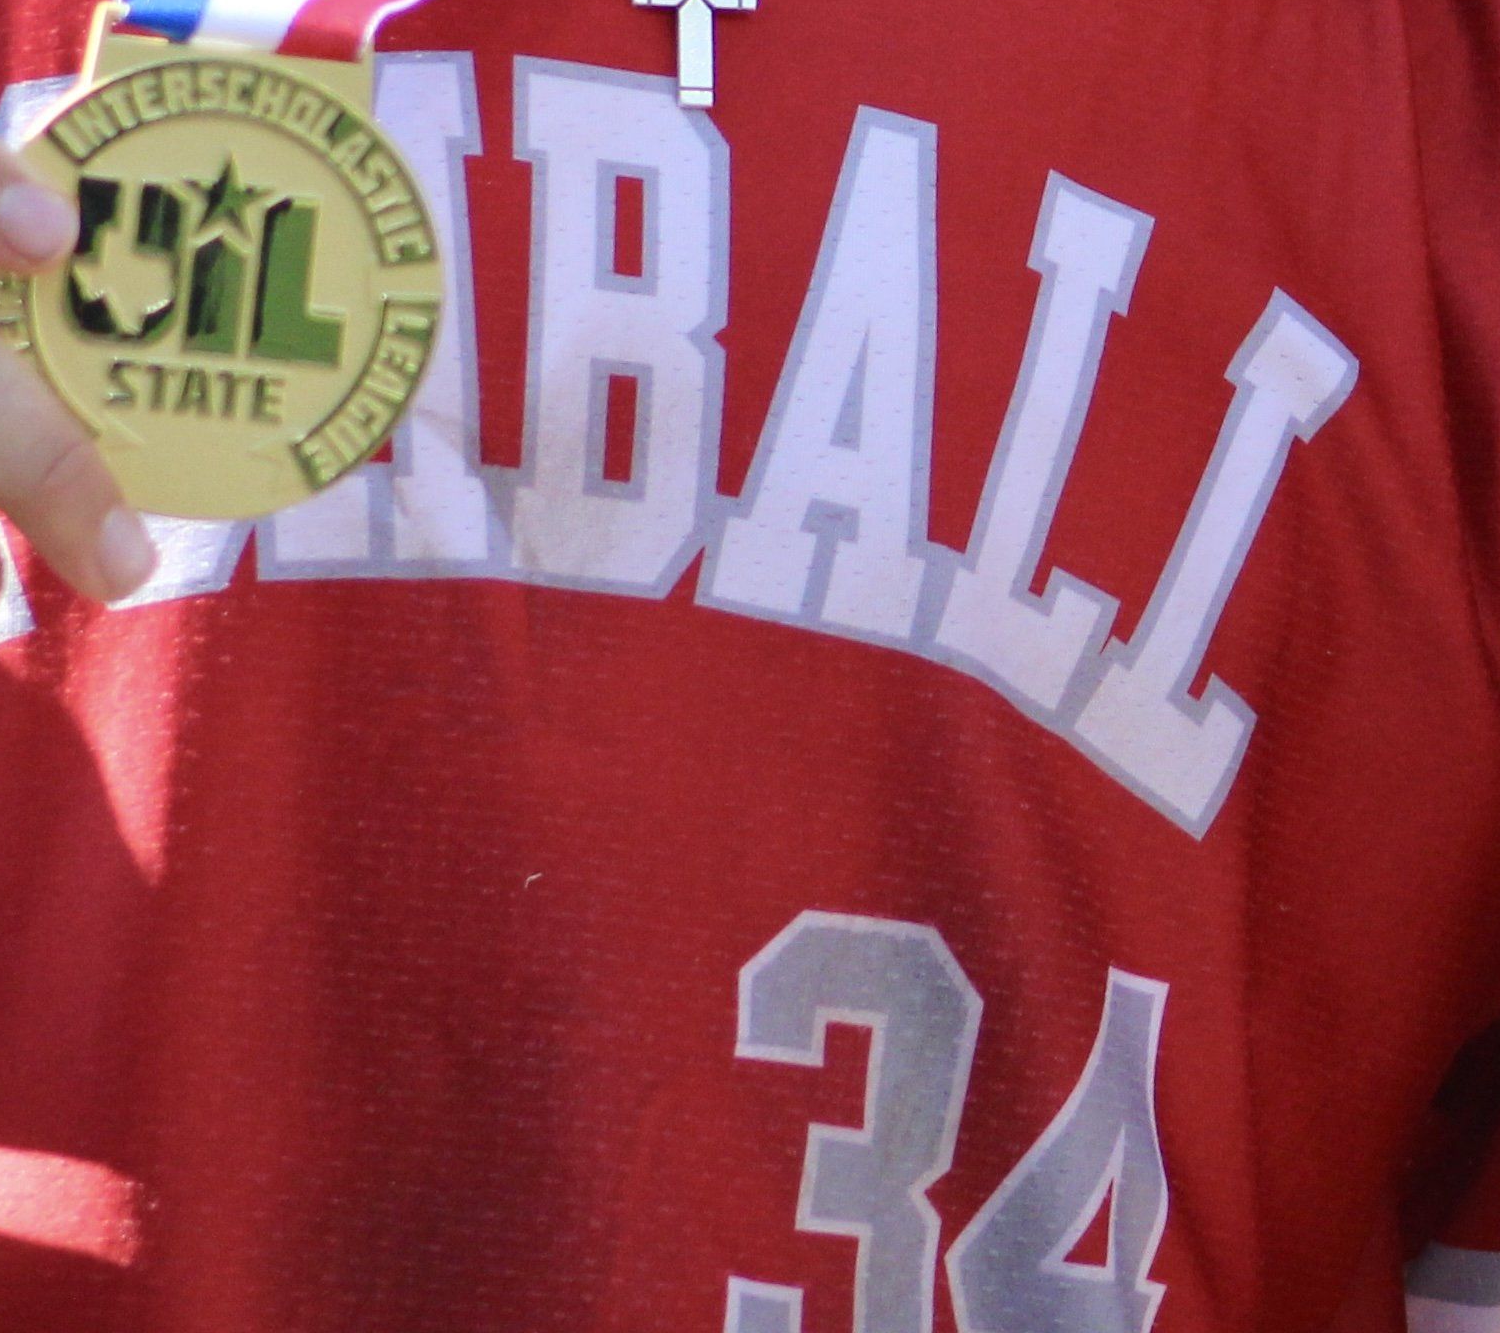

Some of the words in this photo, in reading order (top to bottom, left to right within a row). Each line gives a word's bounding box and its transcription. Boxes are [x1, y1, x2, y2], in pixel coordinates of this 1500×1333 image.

[50, 60, 435, 265] INTERSCHOLASTIC
[292, 293, 443, 489] LEAGUE
[106, 359, 288, 424] STATE
[722, 907, 1172, 1333] 34
